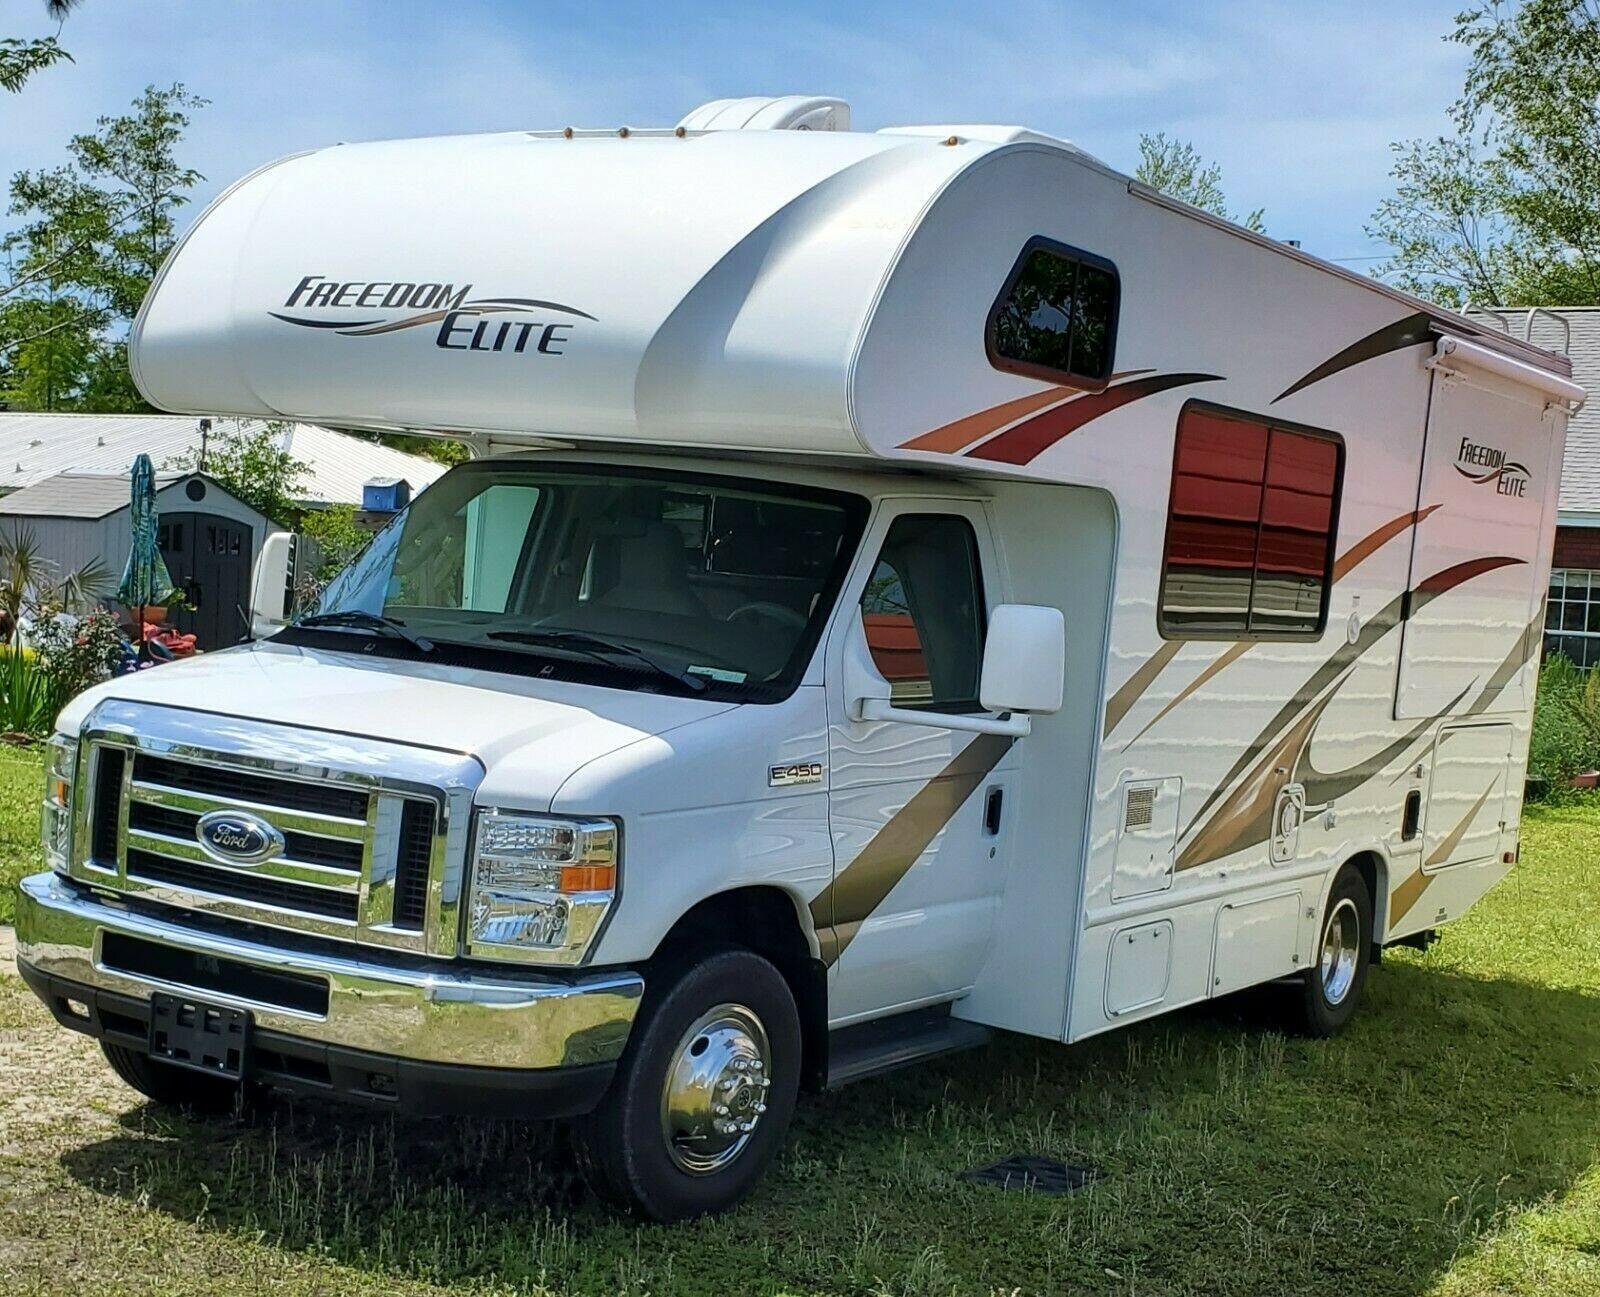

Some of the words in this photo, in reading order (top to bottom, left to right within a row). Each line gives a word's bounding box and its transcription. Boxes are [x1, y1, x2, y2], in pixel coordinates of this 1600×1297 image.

[284, 276, 473, 310] FREEDOM
[436, 311, 574, 356] ELITE
[1458, 436, 1506, 470] FREEDOM
[1496, 470, 1527, 498] ELITE
[212, 823, 251, 848] Ford
